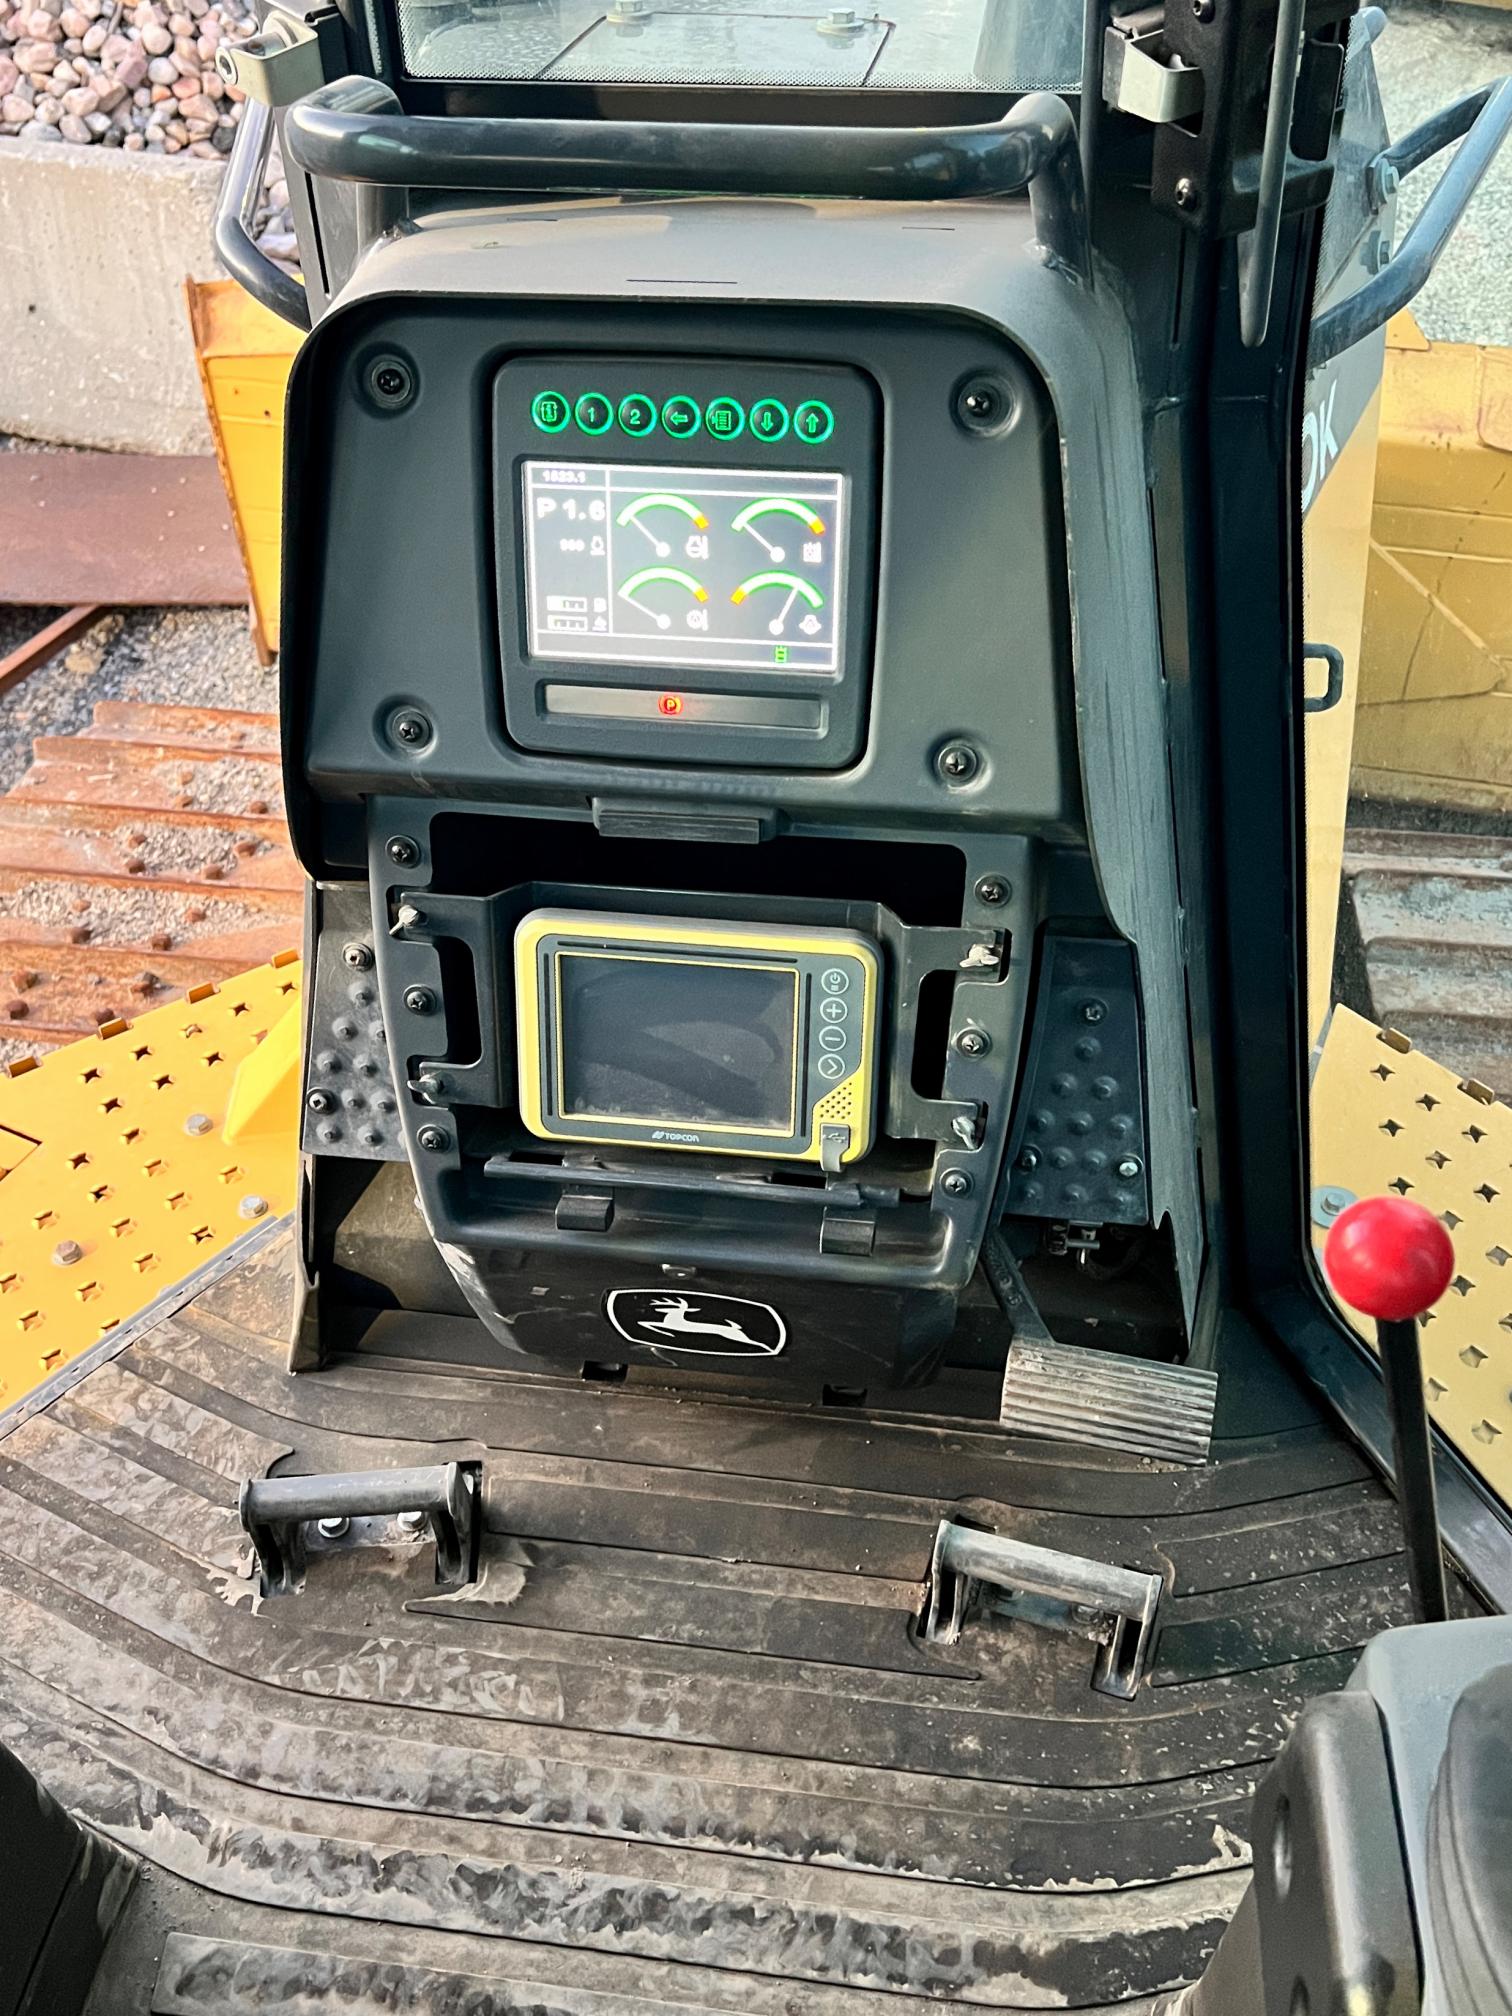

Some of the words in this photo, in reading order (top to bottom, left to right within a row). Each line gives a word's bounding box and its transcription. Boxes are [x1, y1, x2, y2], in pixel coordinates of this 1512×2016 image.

[587, 407, 596, 423] 1
[629, 408, 641, 425] 2
[536, 496, 557, 519] P
[562, 498, 605, 521] 1.6
[664, 1132, 700, 1142] TOPCON
